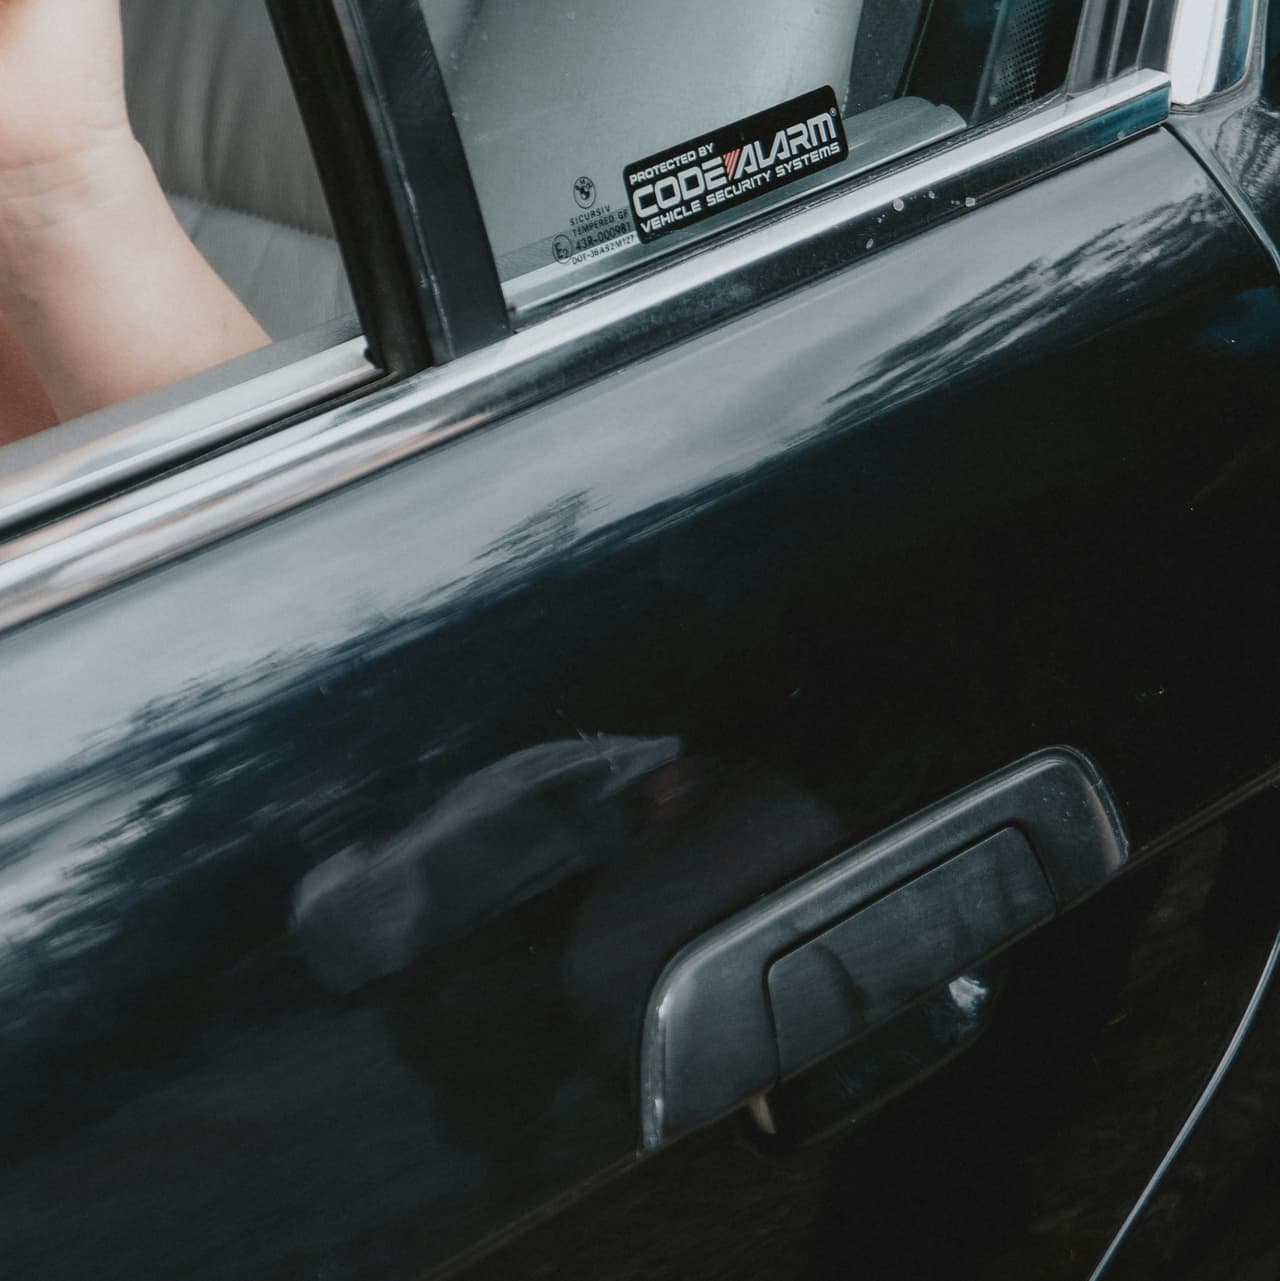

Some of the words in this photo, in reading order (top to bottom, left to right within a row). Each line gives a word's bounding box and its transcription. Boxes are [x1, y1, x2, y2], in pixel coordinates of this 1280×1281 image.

[629, 150, 696, 185] PROTECTED
[698, 142, 714, 157] BY
[633, 156, 728, 218] CODE
[734, 112, 837, 180] ALARM
[640, 200, 702, 233] VEHICLE
[706, 170, 771, 207] SECURITY
[775, 141, 840, 178] SYSTEMS
[572, 214, 614, 237] TEMPERED
